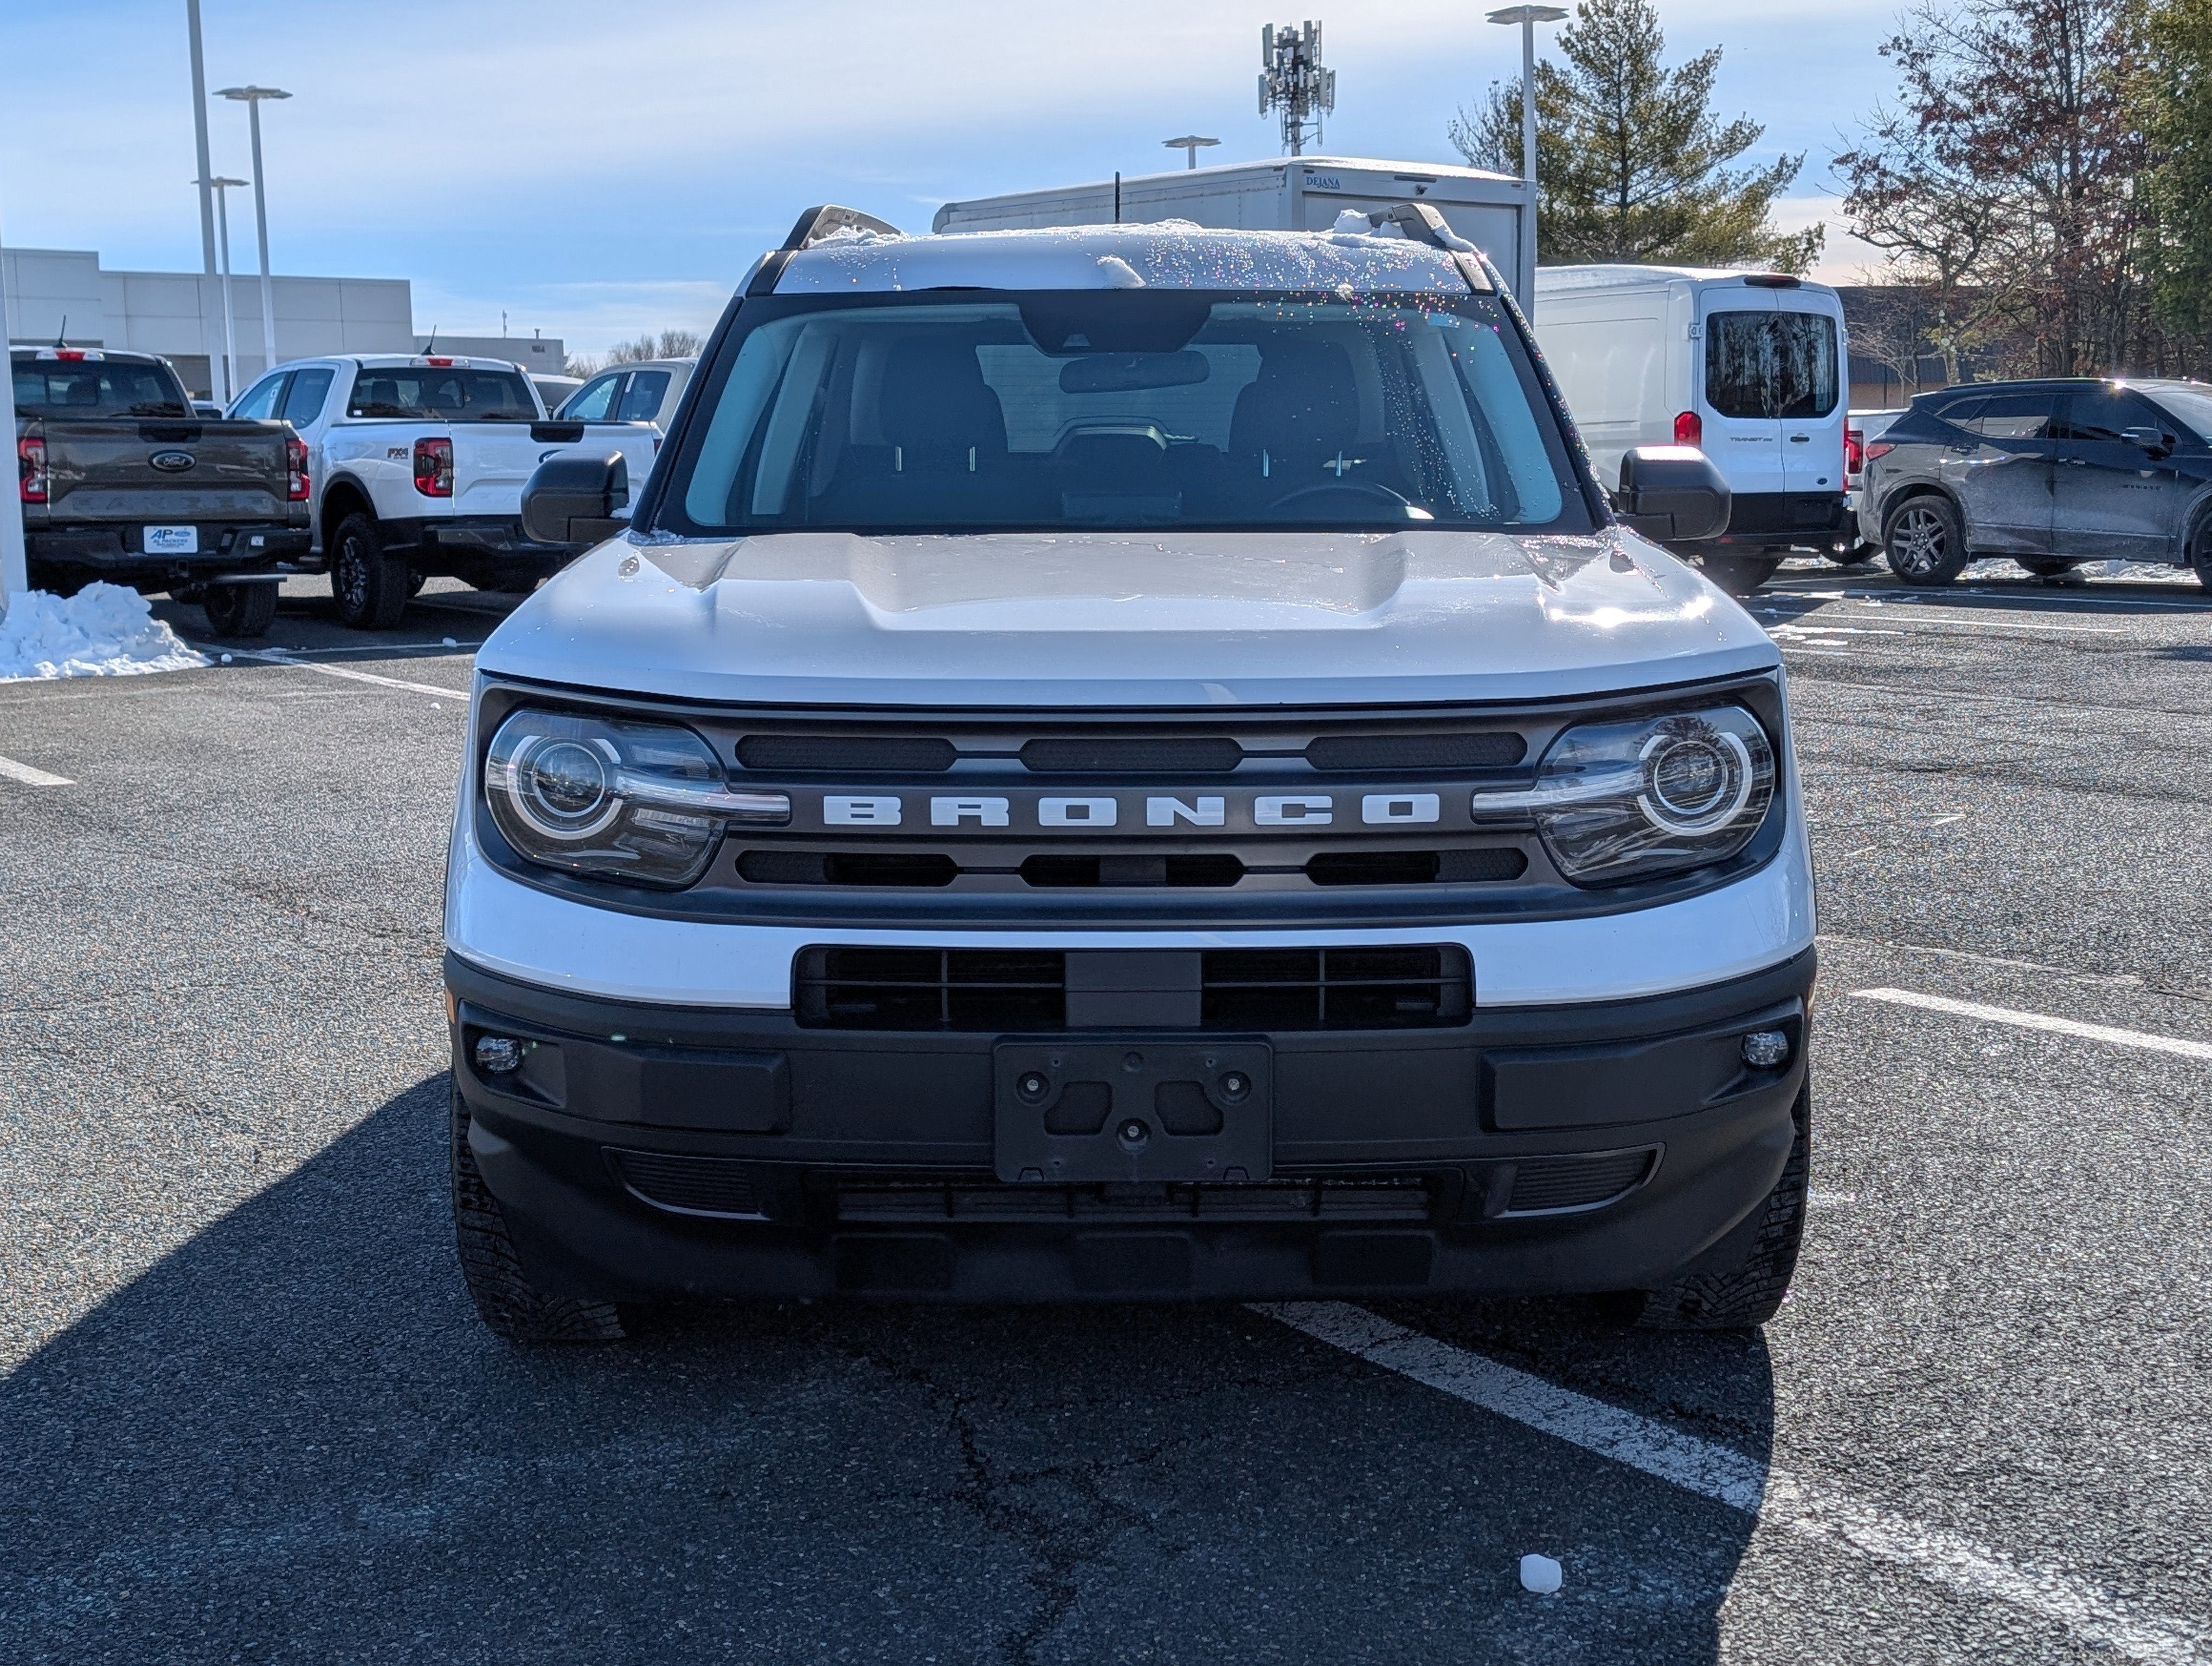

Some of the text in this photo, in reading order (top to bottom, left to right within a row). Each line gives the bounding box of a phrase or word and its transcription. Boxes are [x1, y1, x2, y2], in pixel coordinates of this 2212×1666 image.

[1306, 177, 1340, 188] DEJANA
[387, 447, 409, 458] FX4
[150, 529, 173, 539] AP
[823, 793, 1441, 826] BRONCO
